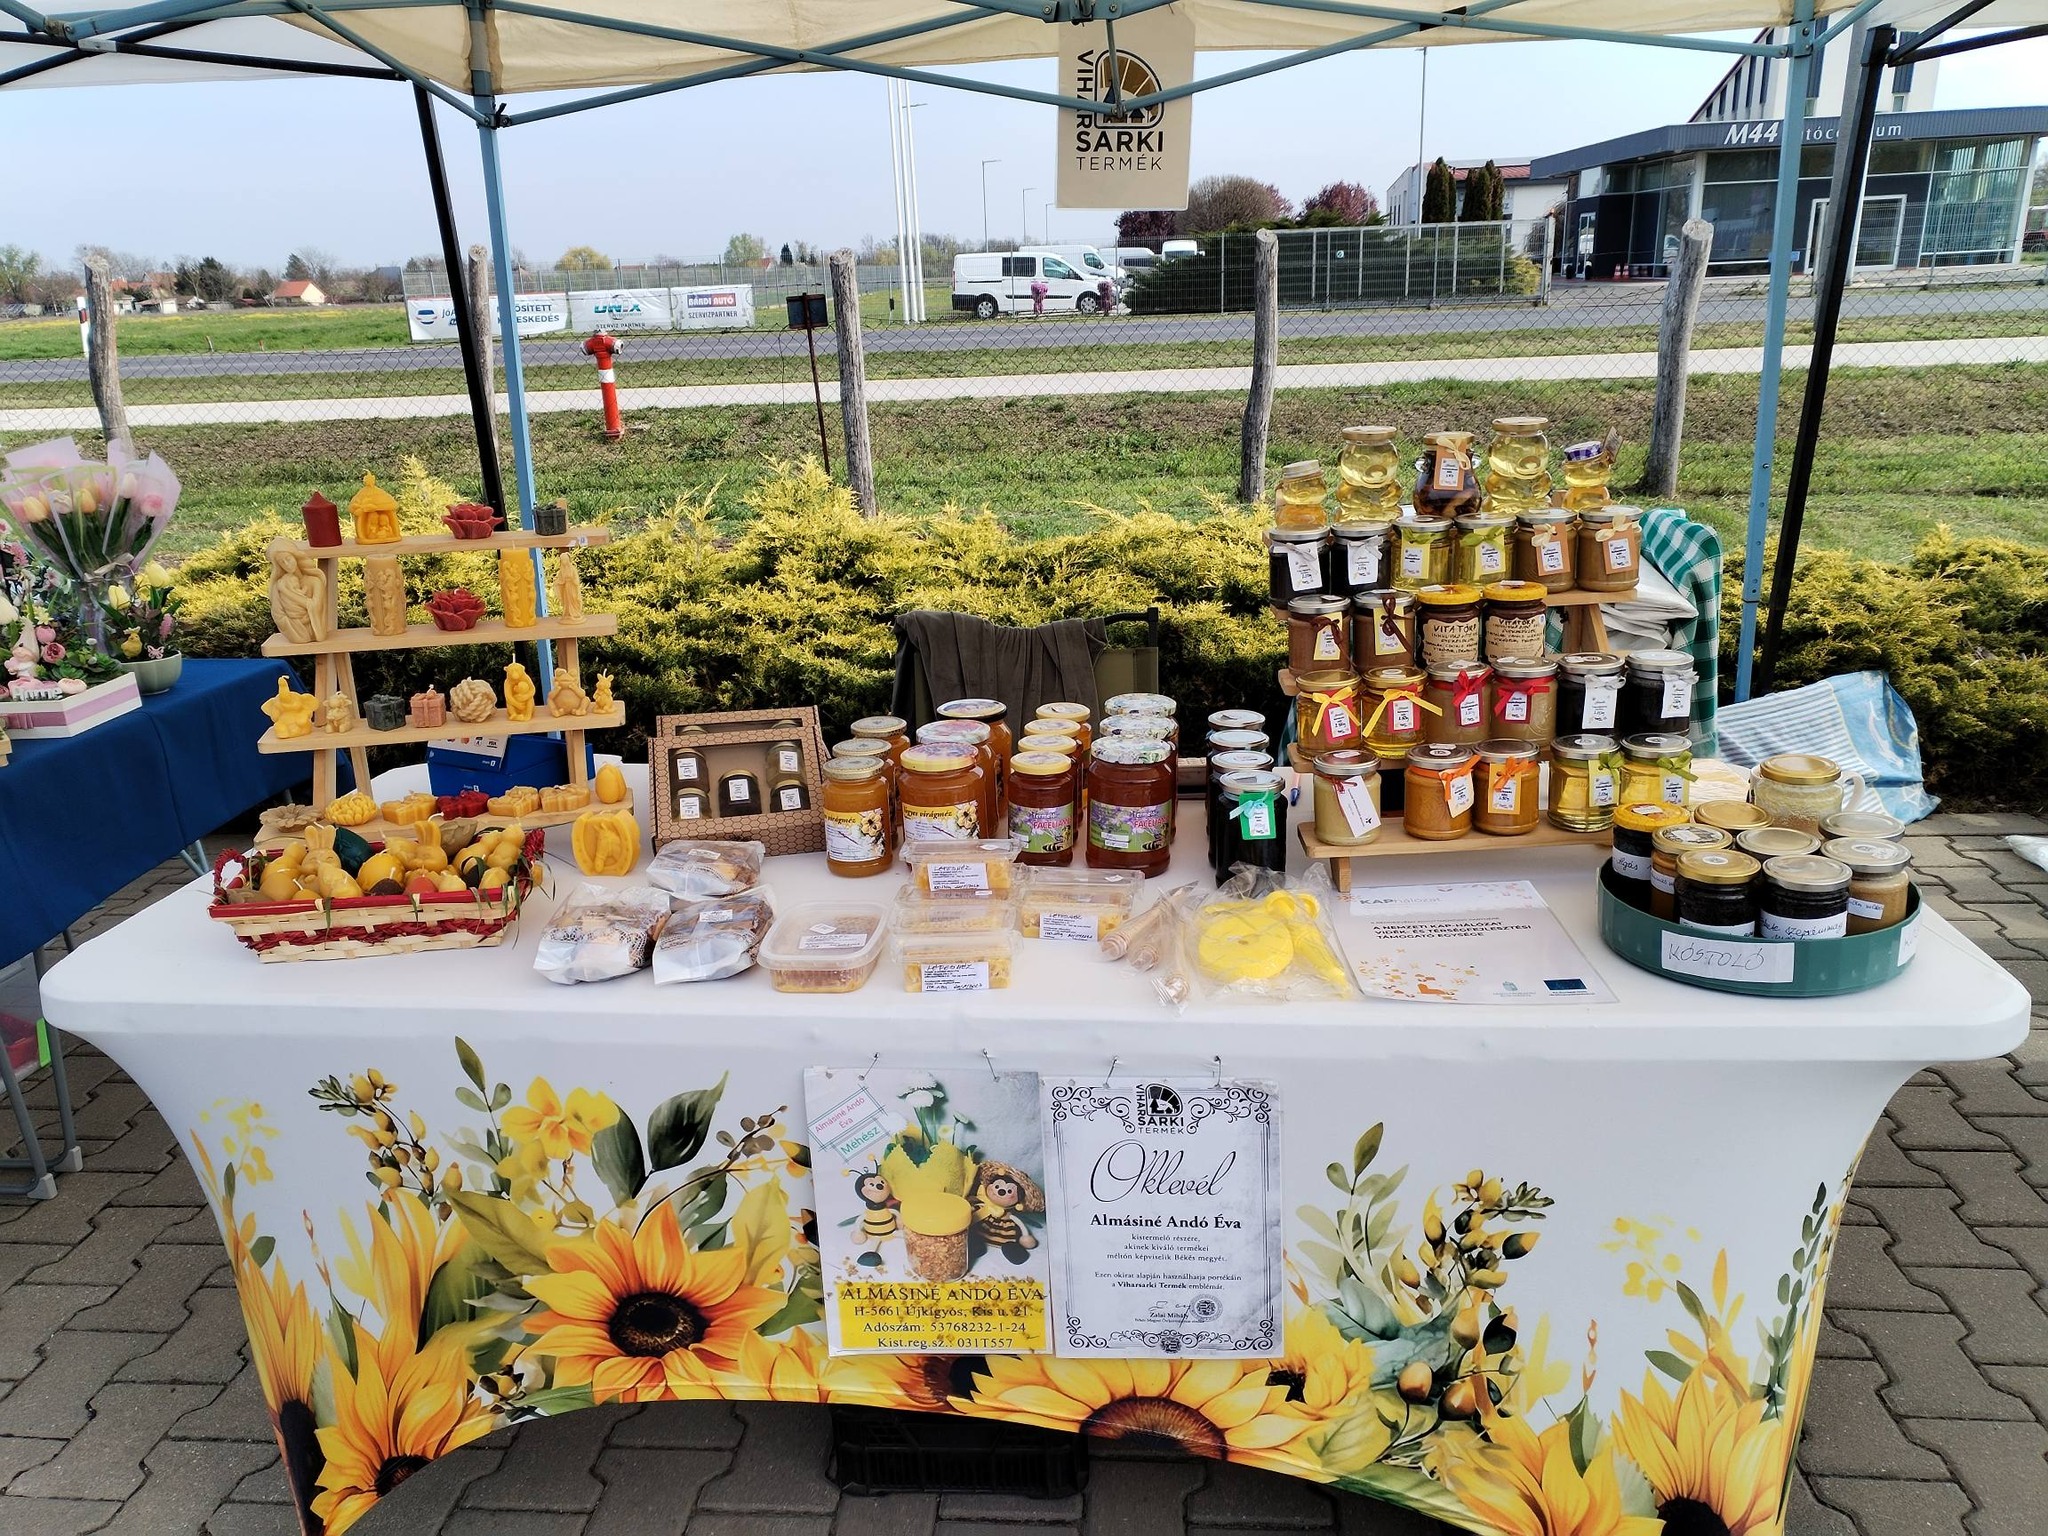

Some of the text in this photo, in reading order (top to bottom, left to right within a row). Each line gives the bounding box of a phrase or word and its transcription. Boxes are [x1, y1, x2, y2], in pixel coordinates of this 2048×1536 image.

[1077, 49, 1094, 129] VIHR
[1724, 122, 1779, 145] M44
[1076, 131, 1164, 153] SARKI
[1076, 154, 1162, 171] TERMÉK
[688, 294, 735, 307] BÁRDI AUTÓ
[688, 310, 738, 319] SZERVIZPARTNER
[1428, 924, 1532, 934] TÉRSÉGFEJLESZTÉSI
[1430, 920, 1503, 929] KAP-HÁLÓZAT
[1438, 931, 1485, 939] EGYSÉGE
[1668, 943, 1765, 971] KÓSTOLÓ
[1136, 1084, 1146, 1116] VIHAR
[815, 1110, 847, 1133] Almásiné
[838, 1117, 854, 1129] Éva
[1138, 1117, 1184, 1127] SARKI
[1138, 1126, 1185, 1135] TERMÉK
[840, 1126, 881, 1155] Méhész
[1090, 1139, 1237, 1203] Oklevél
[1090, 1214, 1242, 1229] Almásiné Andó Éva
[1124, 1243, 1209, 1252] akinek kiváló termékei
[1135, 1253, 1172, 1262] képviselik
[1136, 1272, 1161, 1281] alapján
[1162, 1273, 1206, 1281] használhatja
[1118, 1281, 1157, 1289] Viharsarki
[1159, 1282, 1187, 1290] Termék
[842, 1284, 1045, 1300] ALMÁSINÉ ANDÓ ÉVA
[854, 1306, 900, 1317] H-5661
[971, 1306, 993, 1317] Kis
[998, 1308, 1009, 1317] u.
[1014, 1306, 1033, 1317] 21.
[863, 1322, 1027, 1333] Adószám: 53768232-1-24
[957, 1338, 1014, 1348] 031T557
